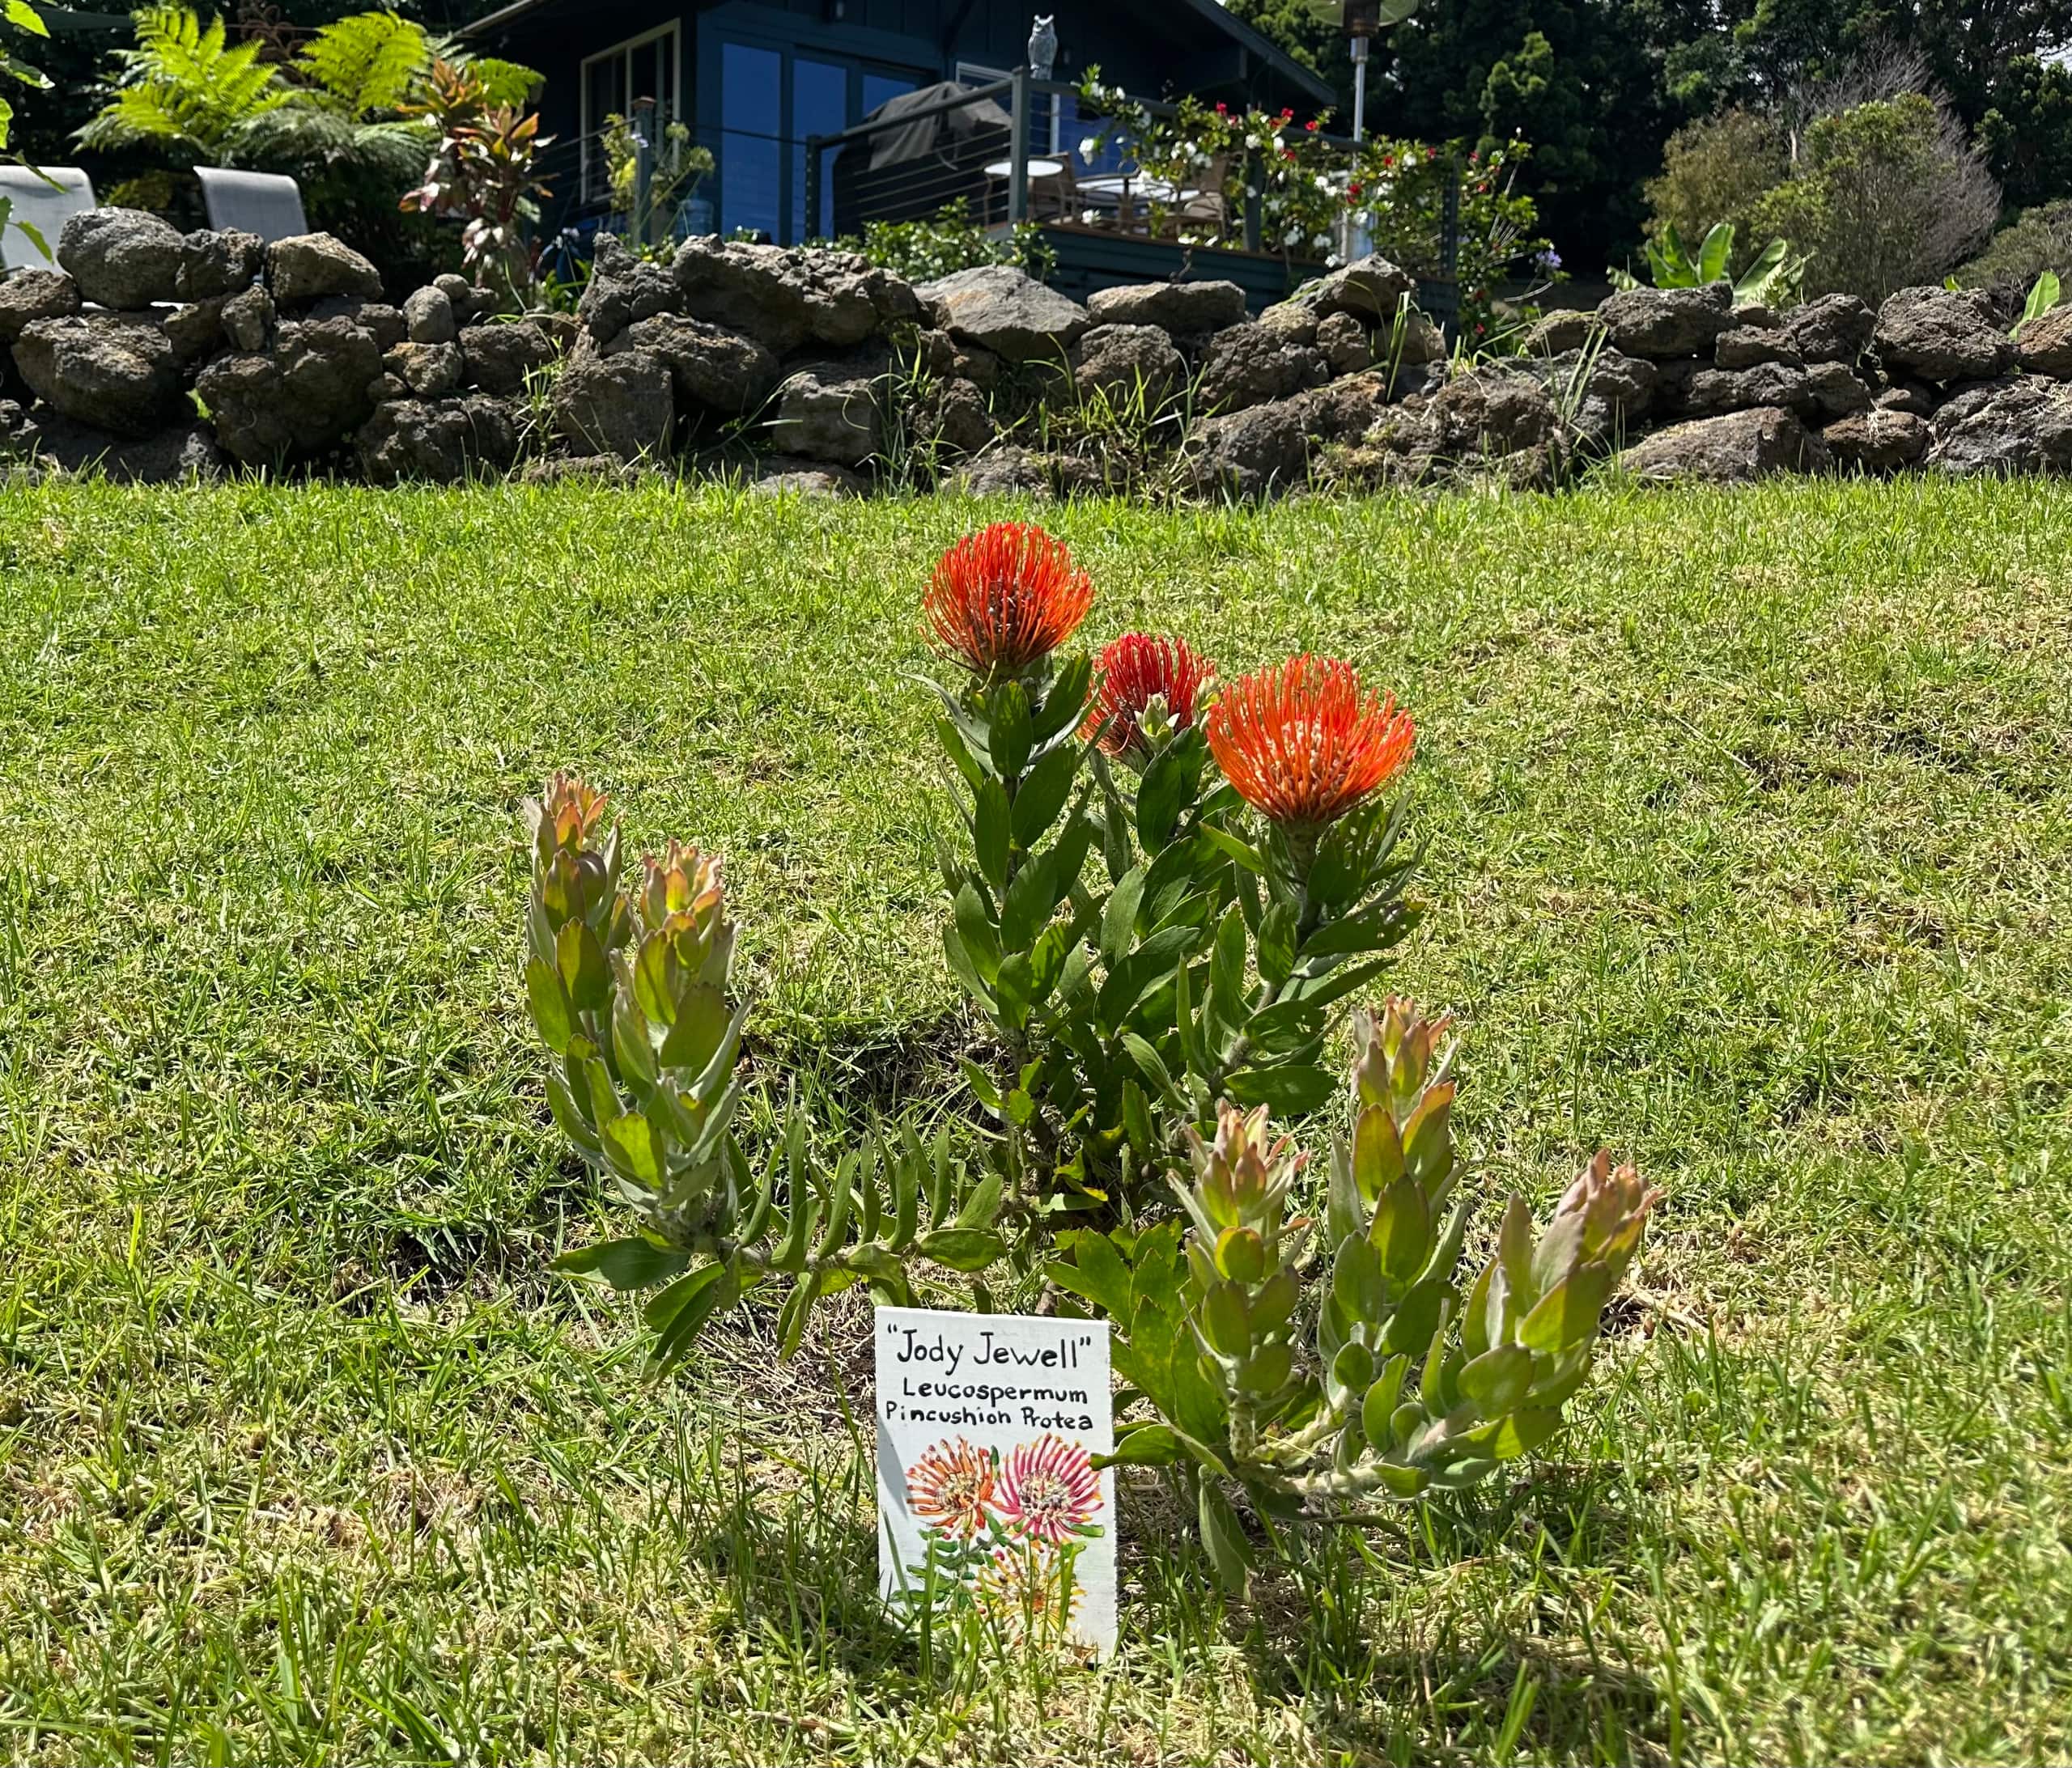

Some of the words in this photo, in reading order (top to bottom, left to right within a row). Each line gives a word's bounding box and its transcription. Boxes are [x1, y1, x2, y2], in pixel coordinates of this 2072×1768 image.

[903, 1377, 1088, 1408] Leucospermum
[886, 1401, 1012, 1426] Pincushion
[1020, 1406, 1093, 1430] Protea
